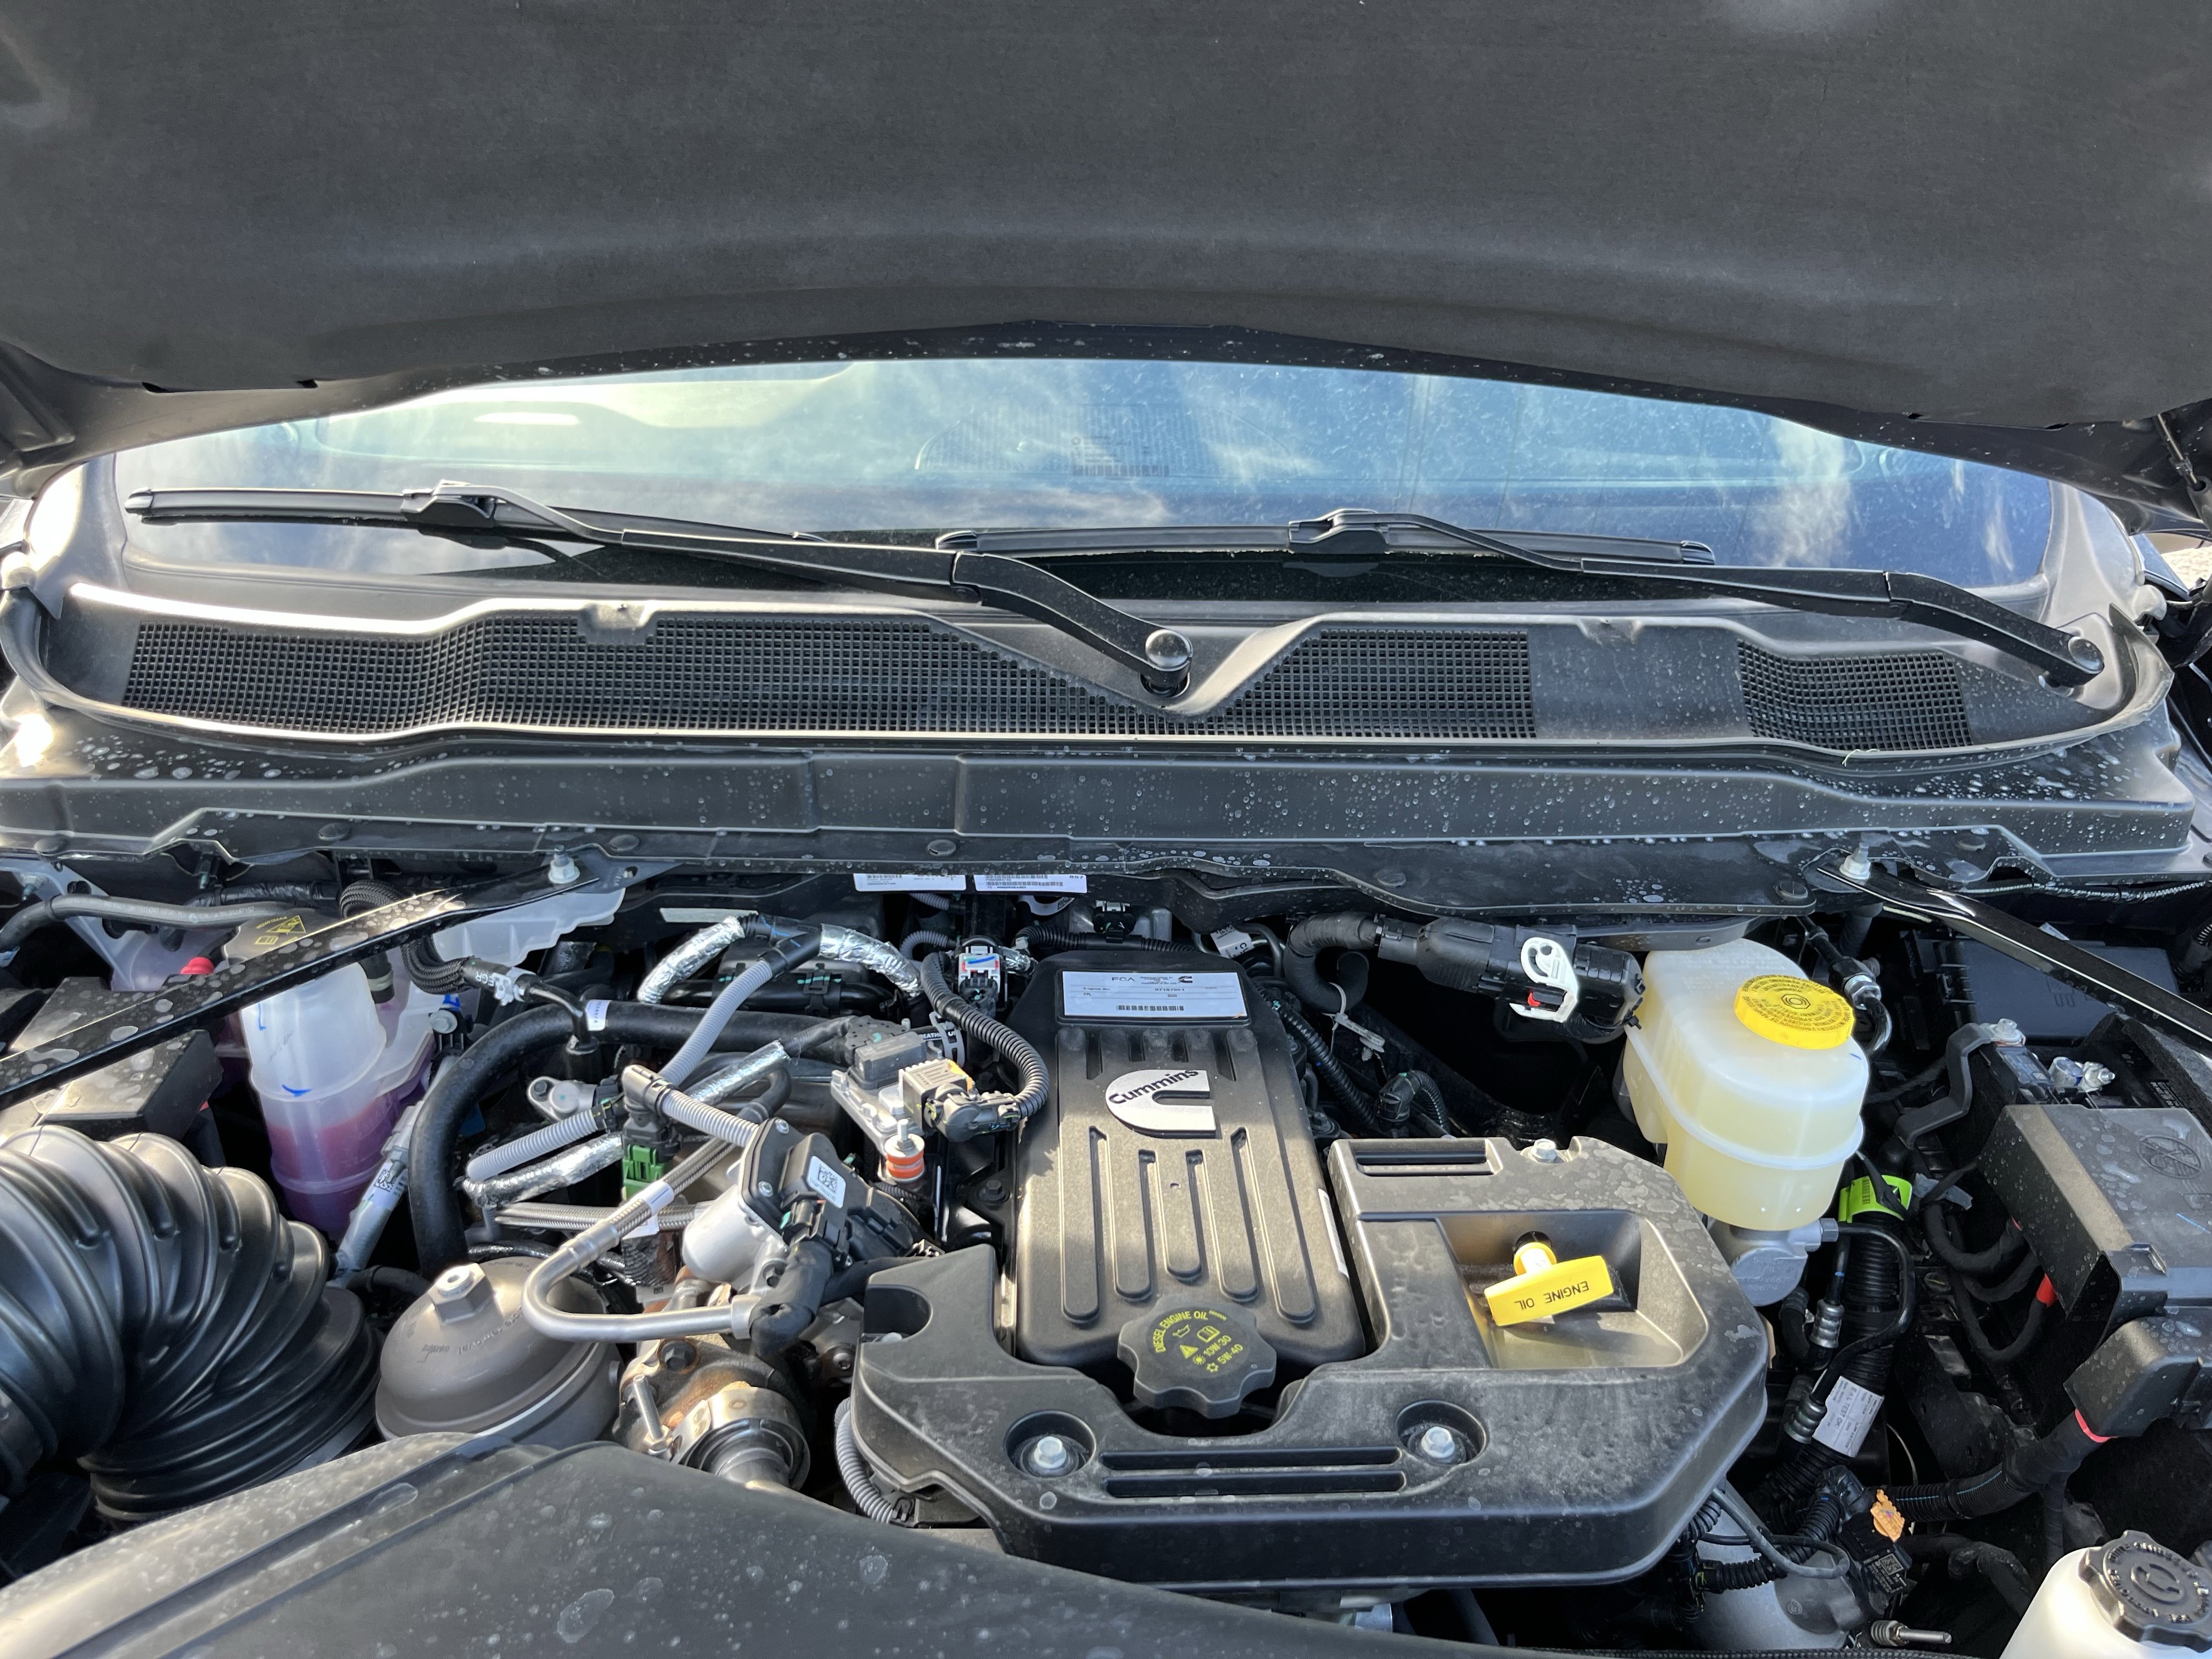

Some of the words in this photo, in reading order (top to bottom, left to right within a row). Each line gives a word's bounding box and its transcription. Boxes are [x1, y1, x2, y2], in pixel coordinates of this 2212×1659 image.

[476, 971, 494, 986] EGR
[1109, 1070, 1199, 1104] Cummins
[1543, 1281, 1589, 1304] ENGINE
[1514, 1297, 1535, 1310] OIL
[1159, 1311, 1192, 1329] ENGINE
[1193, 1311, 1209, 1321] OIL
[1153, 1328, 1166, 1353] DIESEL
[1217, 1344, 1243, 1364] 5W-40
[1839, 1402, 1849, 1417] TEST
[1835, 1417, 1843, 1427] OK
